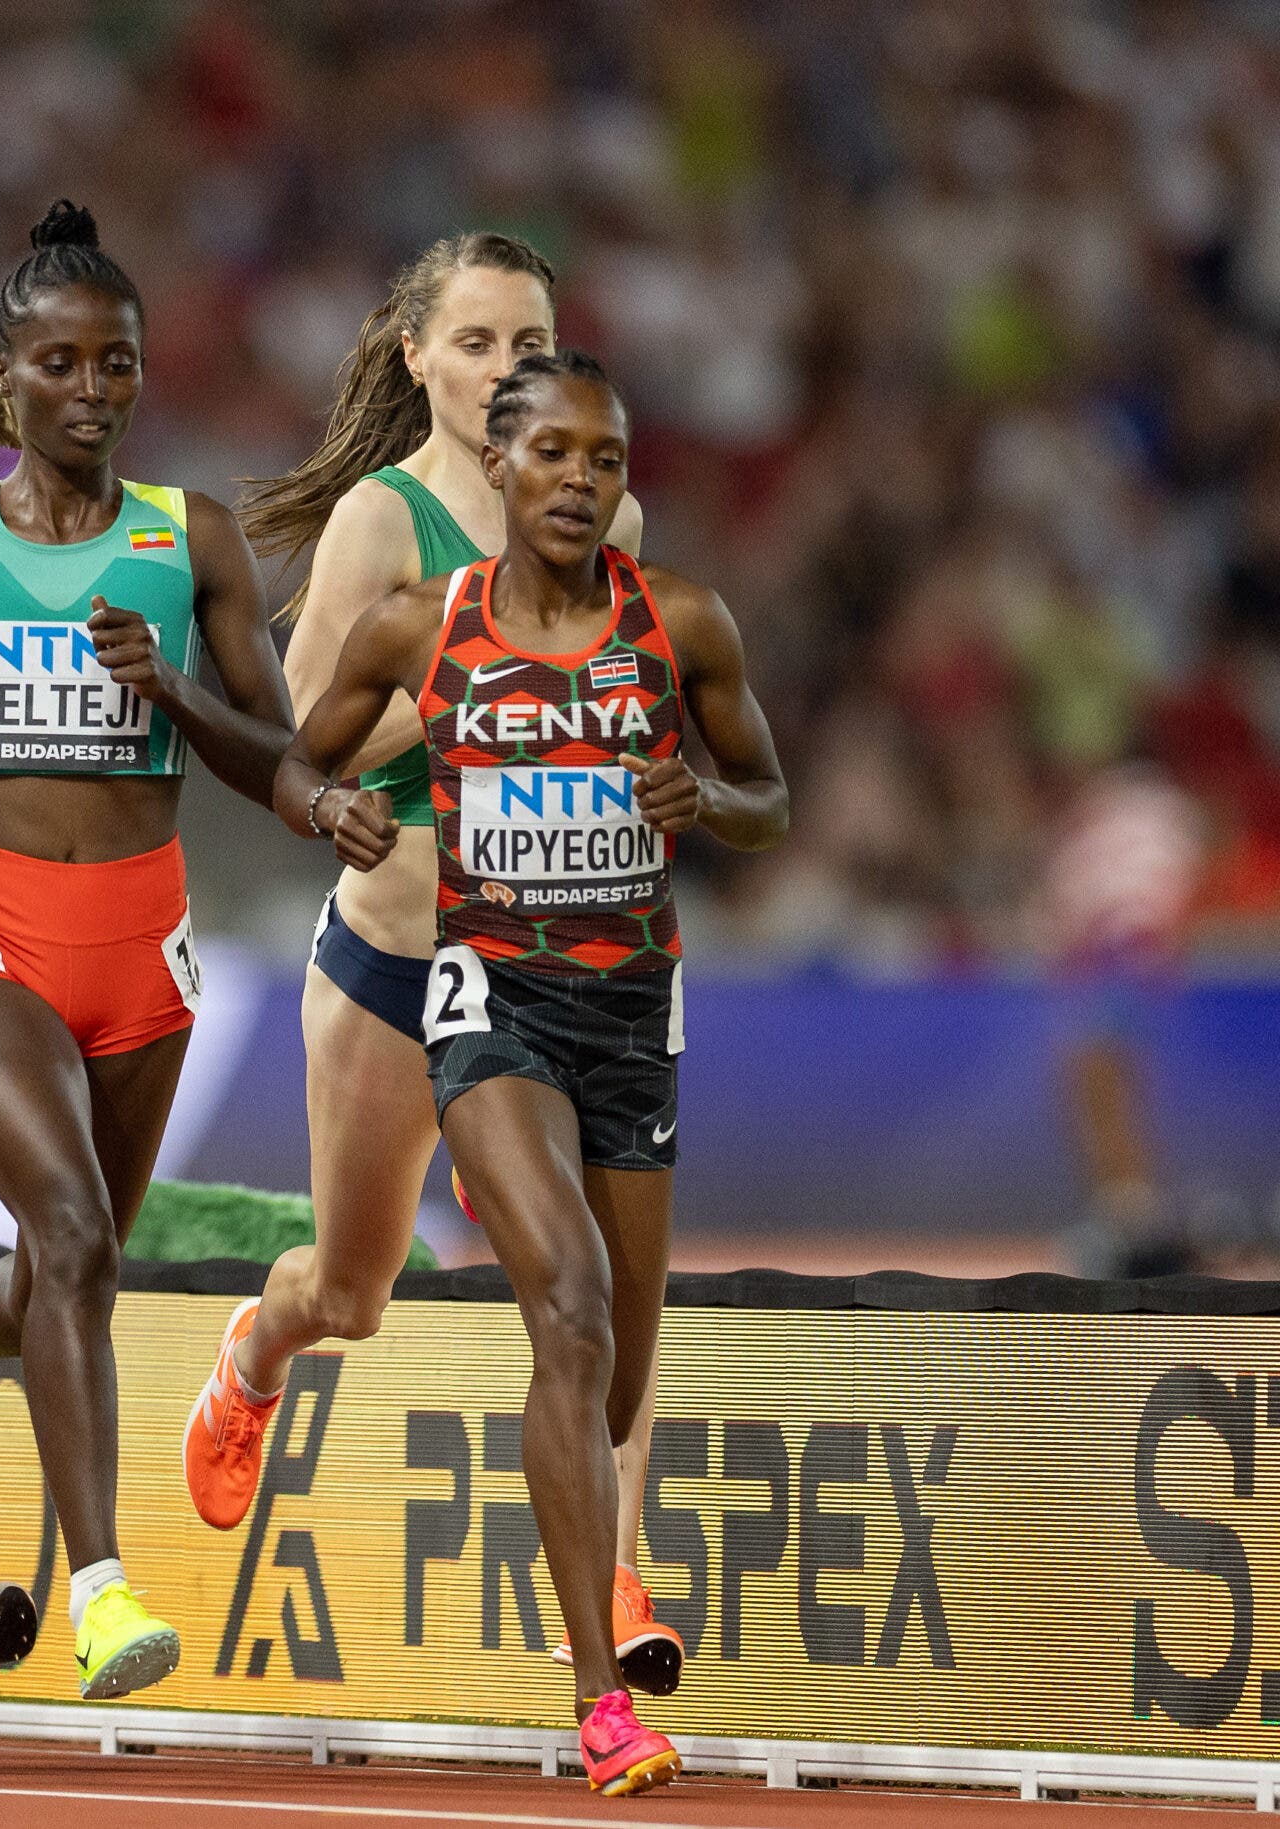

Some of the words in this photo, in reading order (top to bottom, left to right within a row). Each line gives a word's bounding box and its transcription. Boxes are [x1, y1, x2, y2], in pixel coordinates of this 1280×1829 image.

[455, 696, 653, 743] KENYA
[0, 743, 114, 761] BUDAPEST
[115, 745, 136, 764] 23
[500, 772, 633, 820] NTN
[472, 824, 656, 873] KIPYEGON
[523, 885, 633, 905] BUDAPEST
[633, 881, 654, 899] 23
[435, 961, 466, 1025] 2
[404, 1410, 960, 1669] PRSPEX
[1132, 1365, 1280, 1731] S
